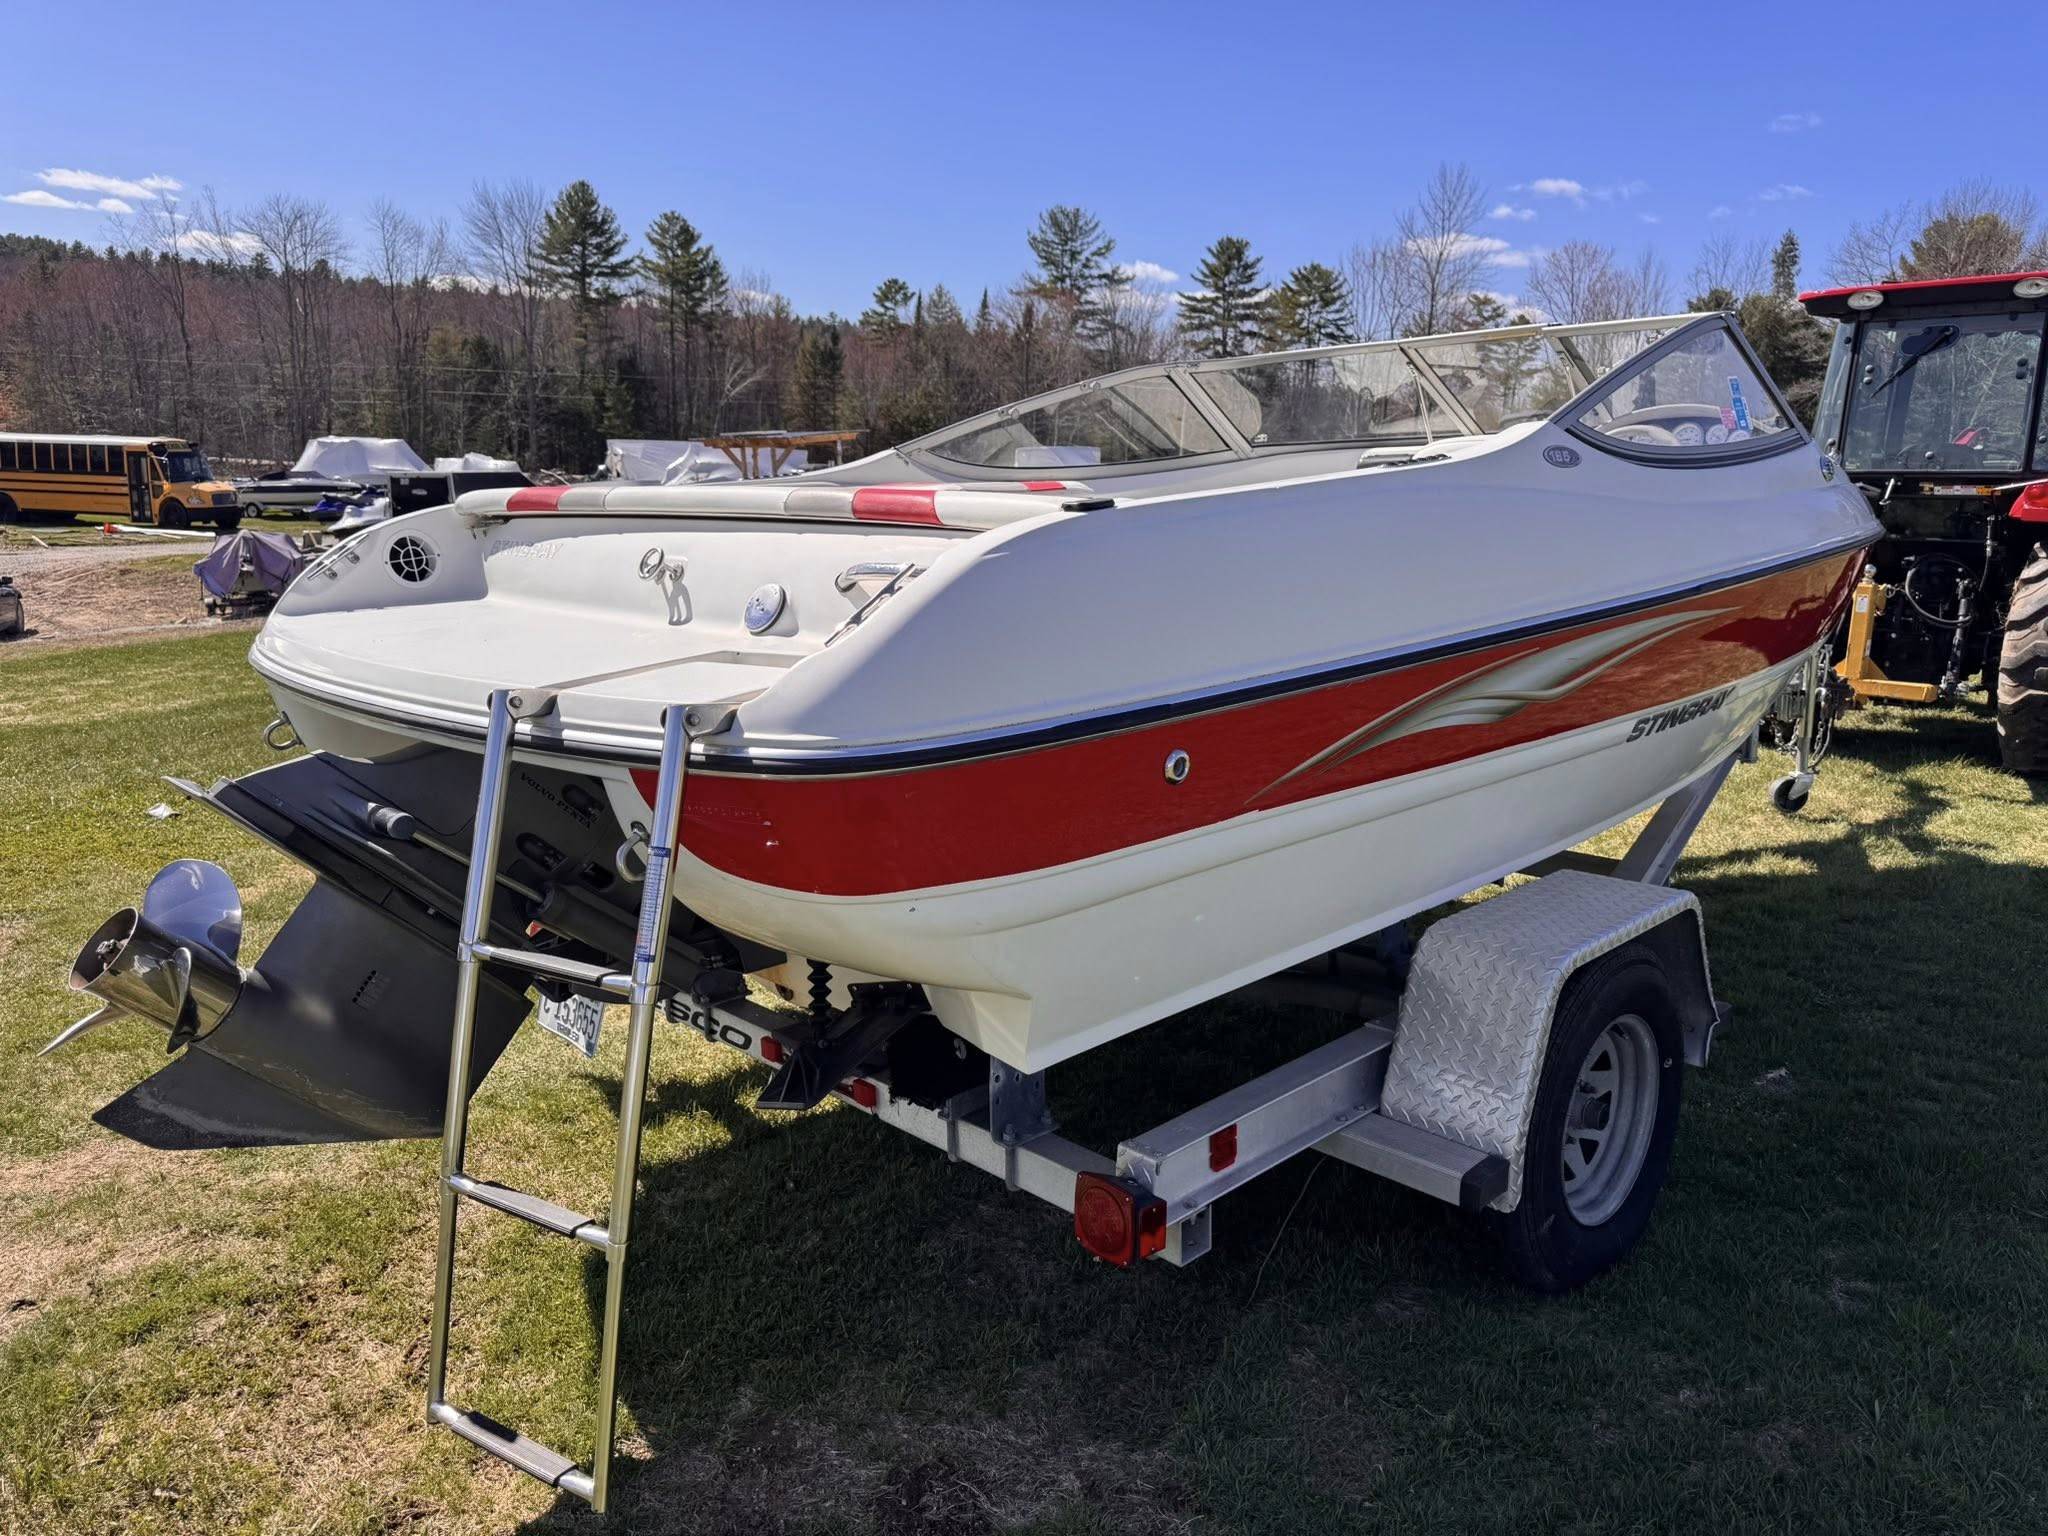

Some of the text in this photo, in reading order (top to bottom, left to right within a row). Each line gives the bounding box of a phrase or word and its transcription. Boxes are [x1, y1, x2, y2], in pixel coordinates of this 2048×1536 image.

[1626, 686, 1736, 742] STINGRAY
[520, 771, 592, 830] VOLVO PENTA
